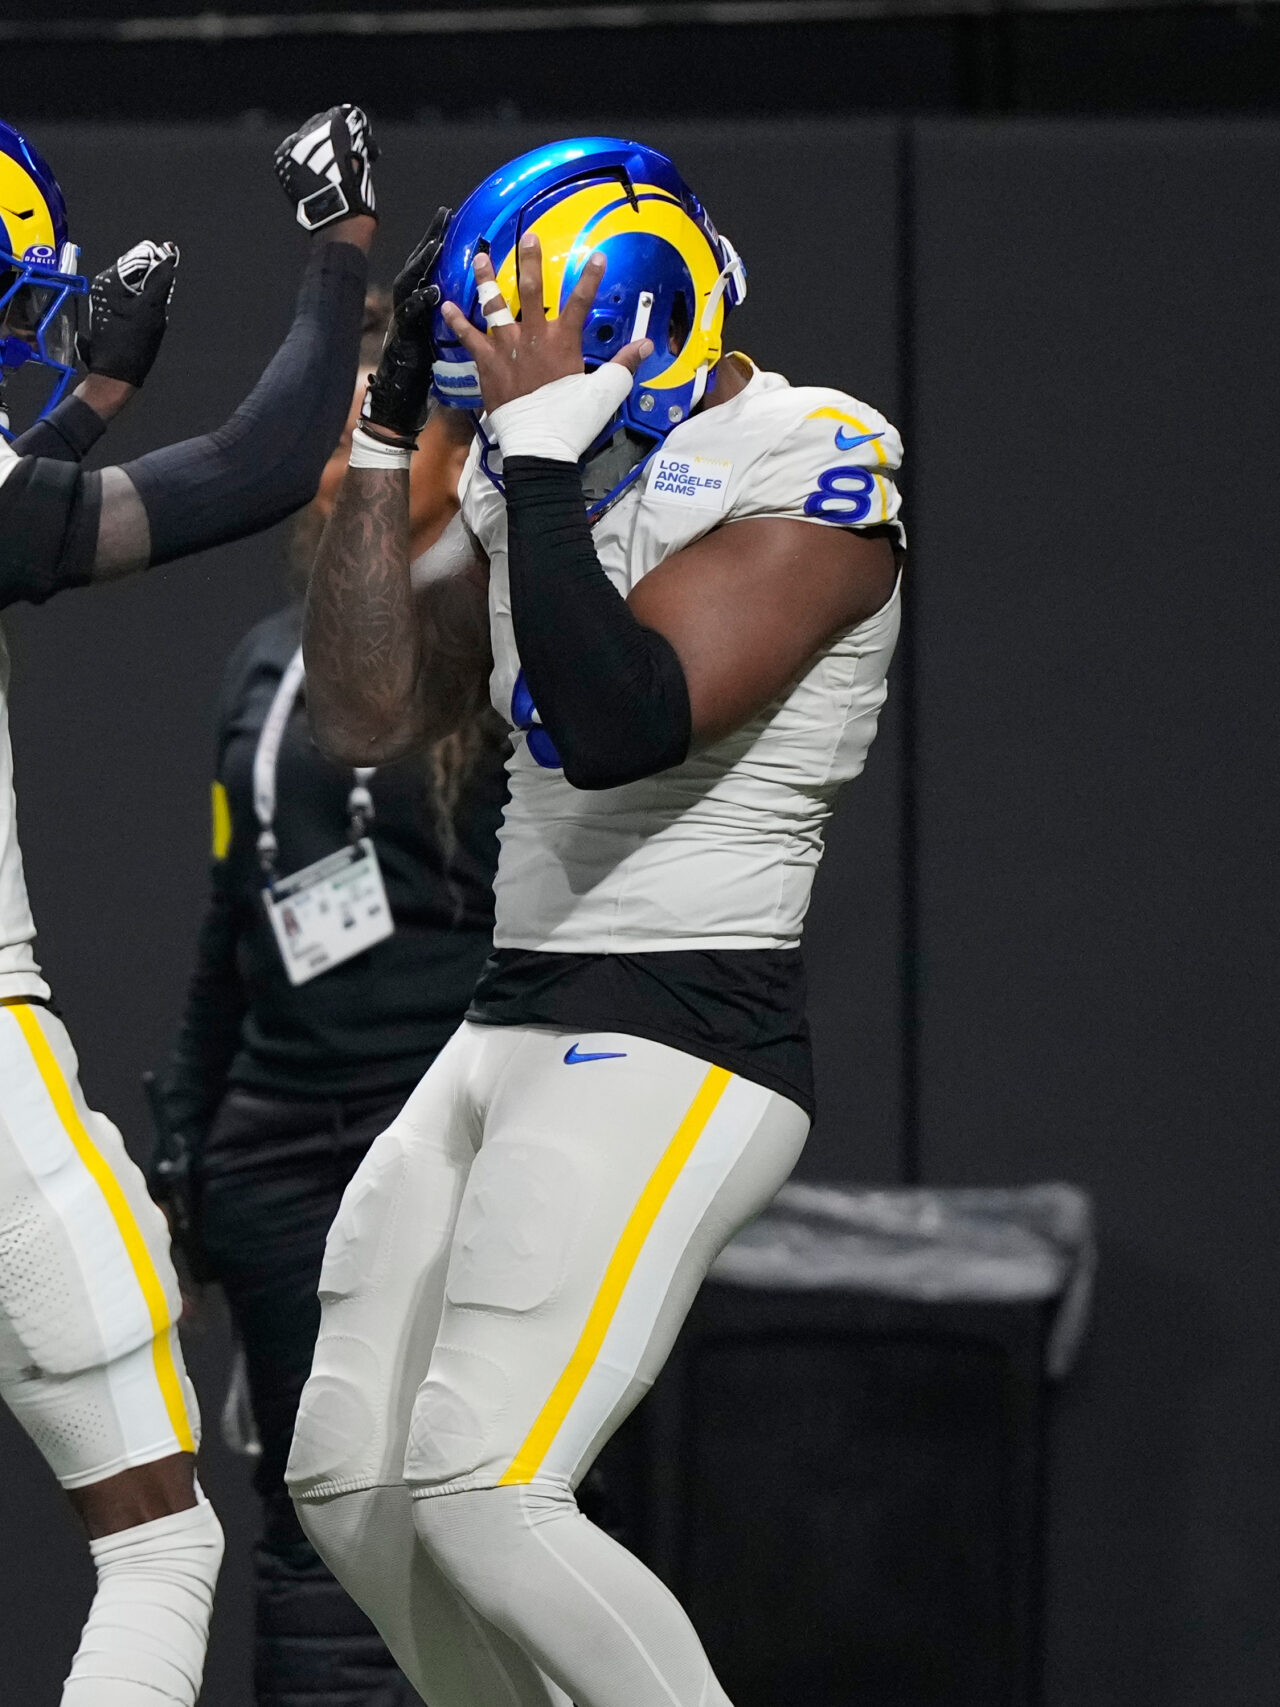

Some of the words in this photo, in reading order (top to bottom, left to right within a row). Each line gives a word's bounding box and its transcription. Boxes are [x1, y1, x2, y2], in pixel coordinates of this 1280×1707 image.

[24, 256, 57, 265] OAKLEY
[659, 459, 690, 474] LOS
[654, 480, 696, 496] RAMS
[656, 470, 722, 490] ANGELES
[803, 465, 875, 524] 8
